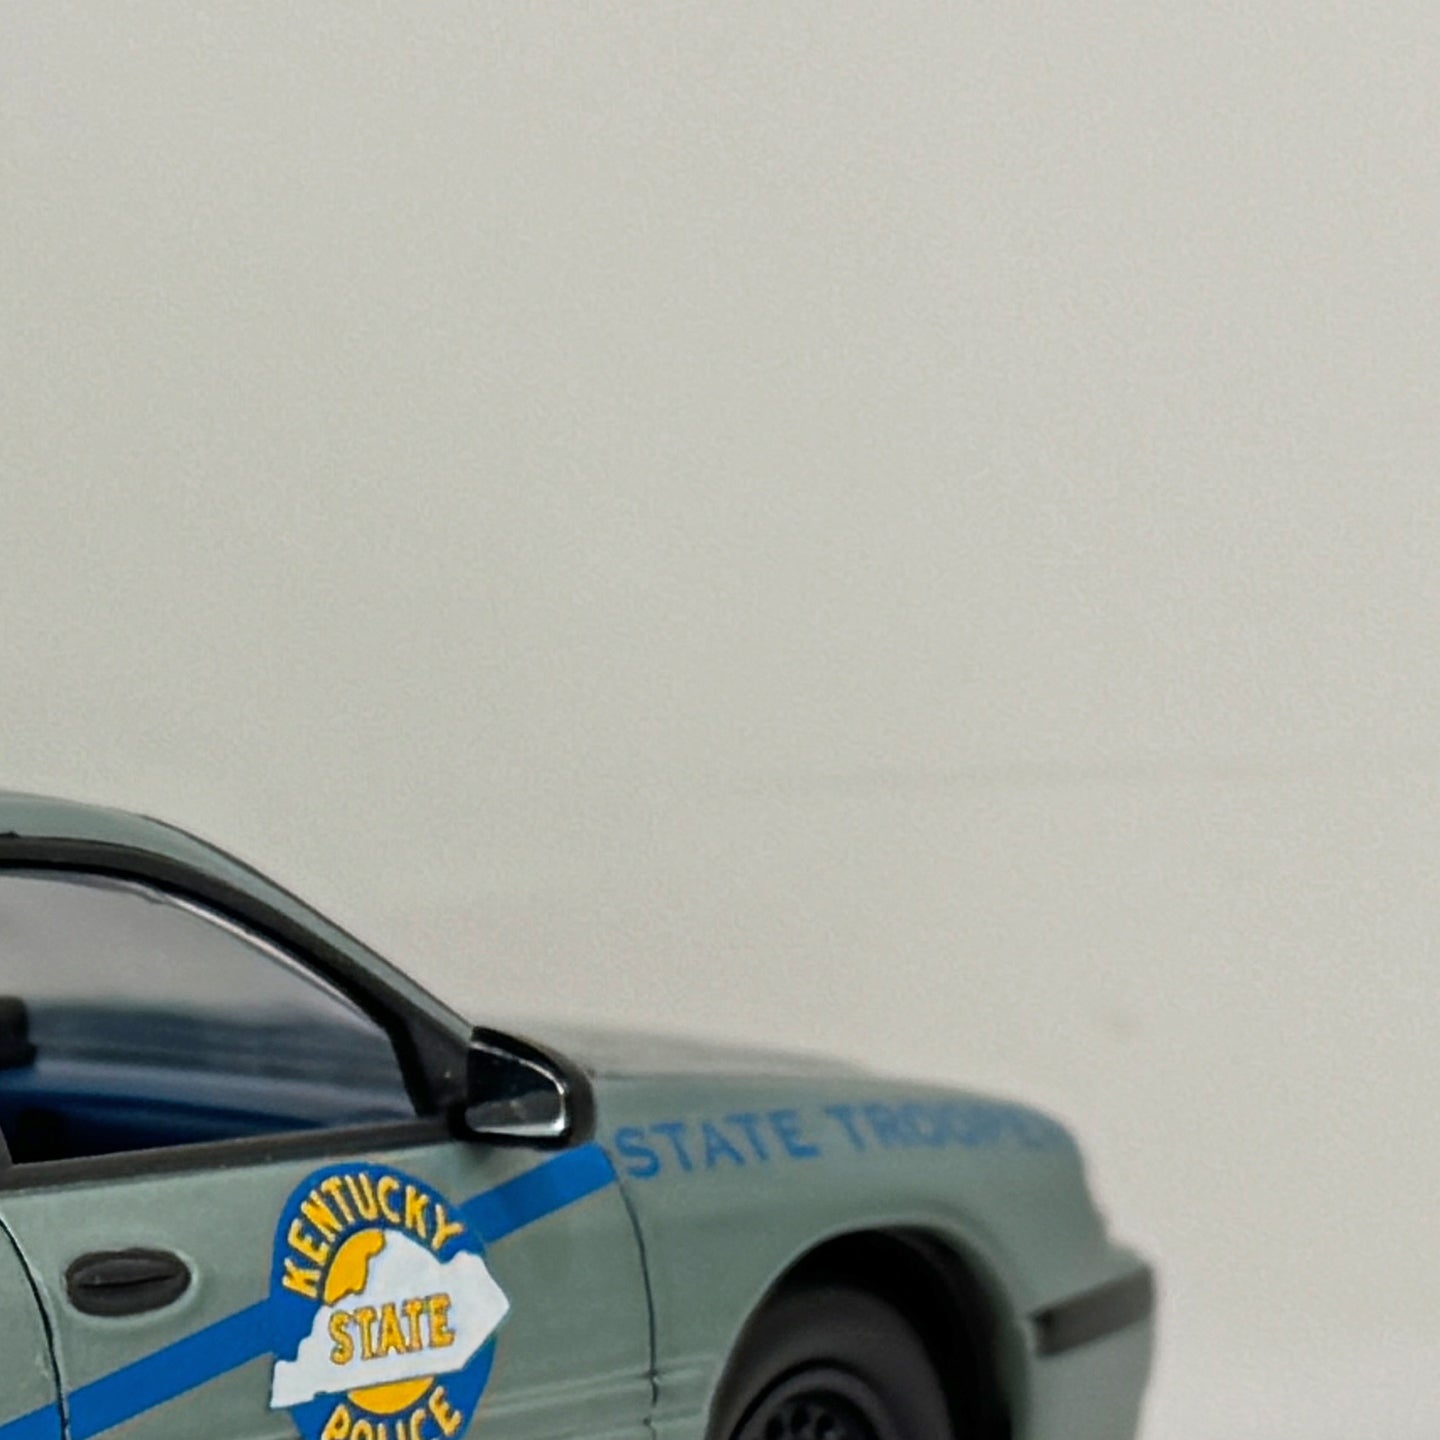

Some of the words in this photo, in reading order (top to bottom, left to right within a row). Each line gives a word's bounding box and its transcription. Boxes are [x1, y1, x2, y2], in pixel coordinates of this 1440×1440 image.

[614, 1109, 819, 1180] STATE
[282, 1173, 465, 1299] KENTUCKY
[328, 1294, 456, 1365] STATE
